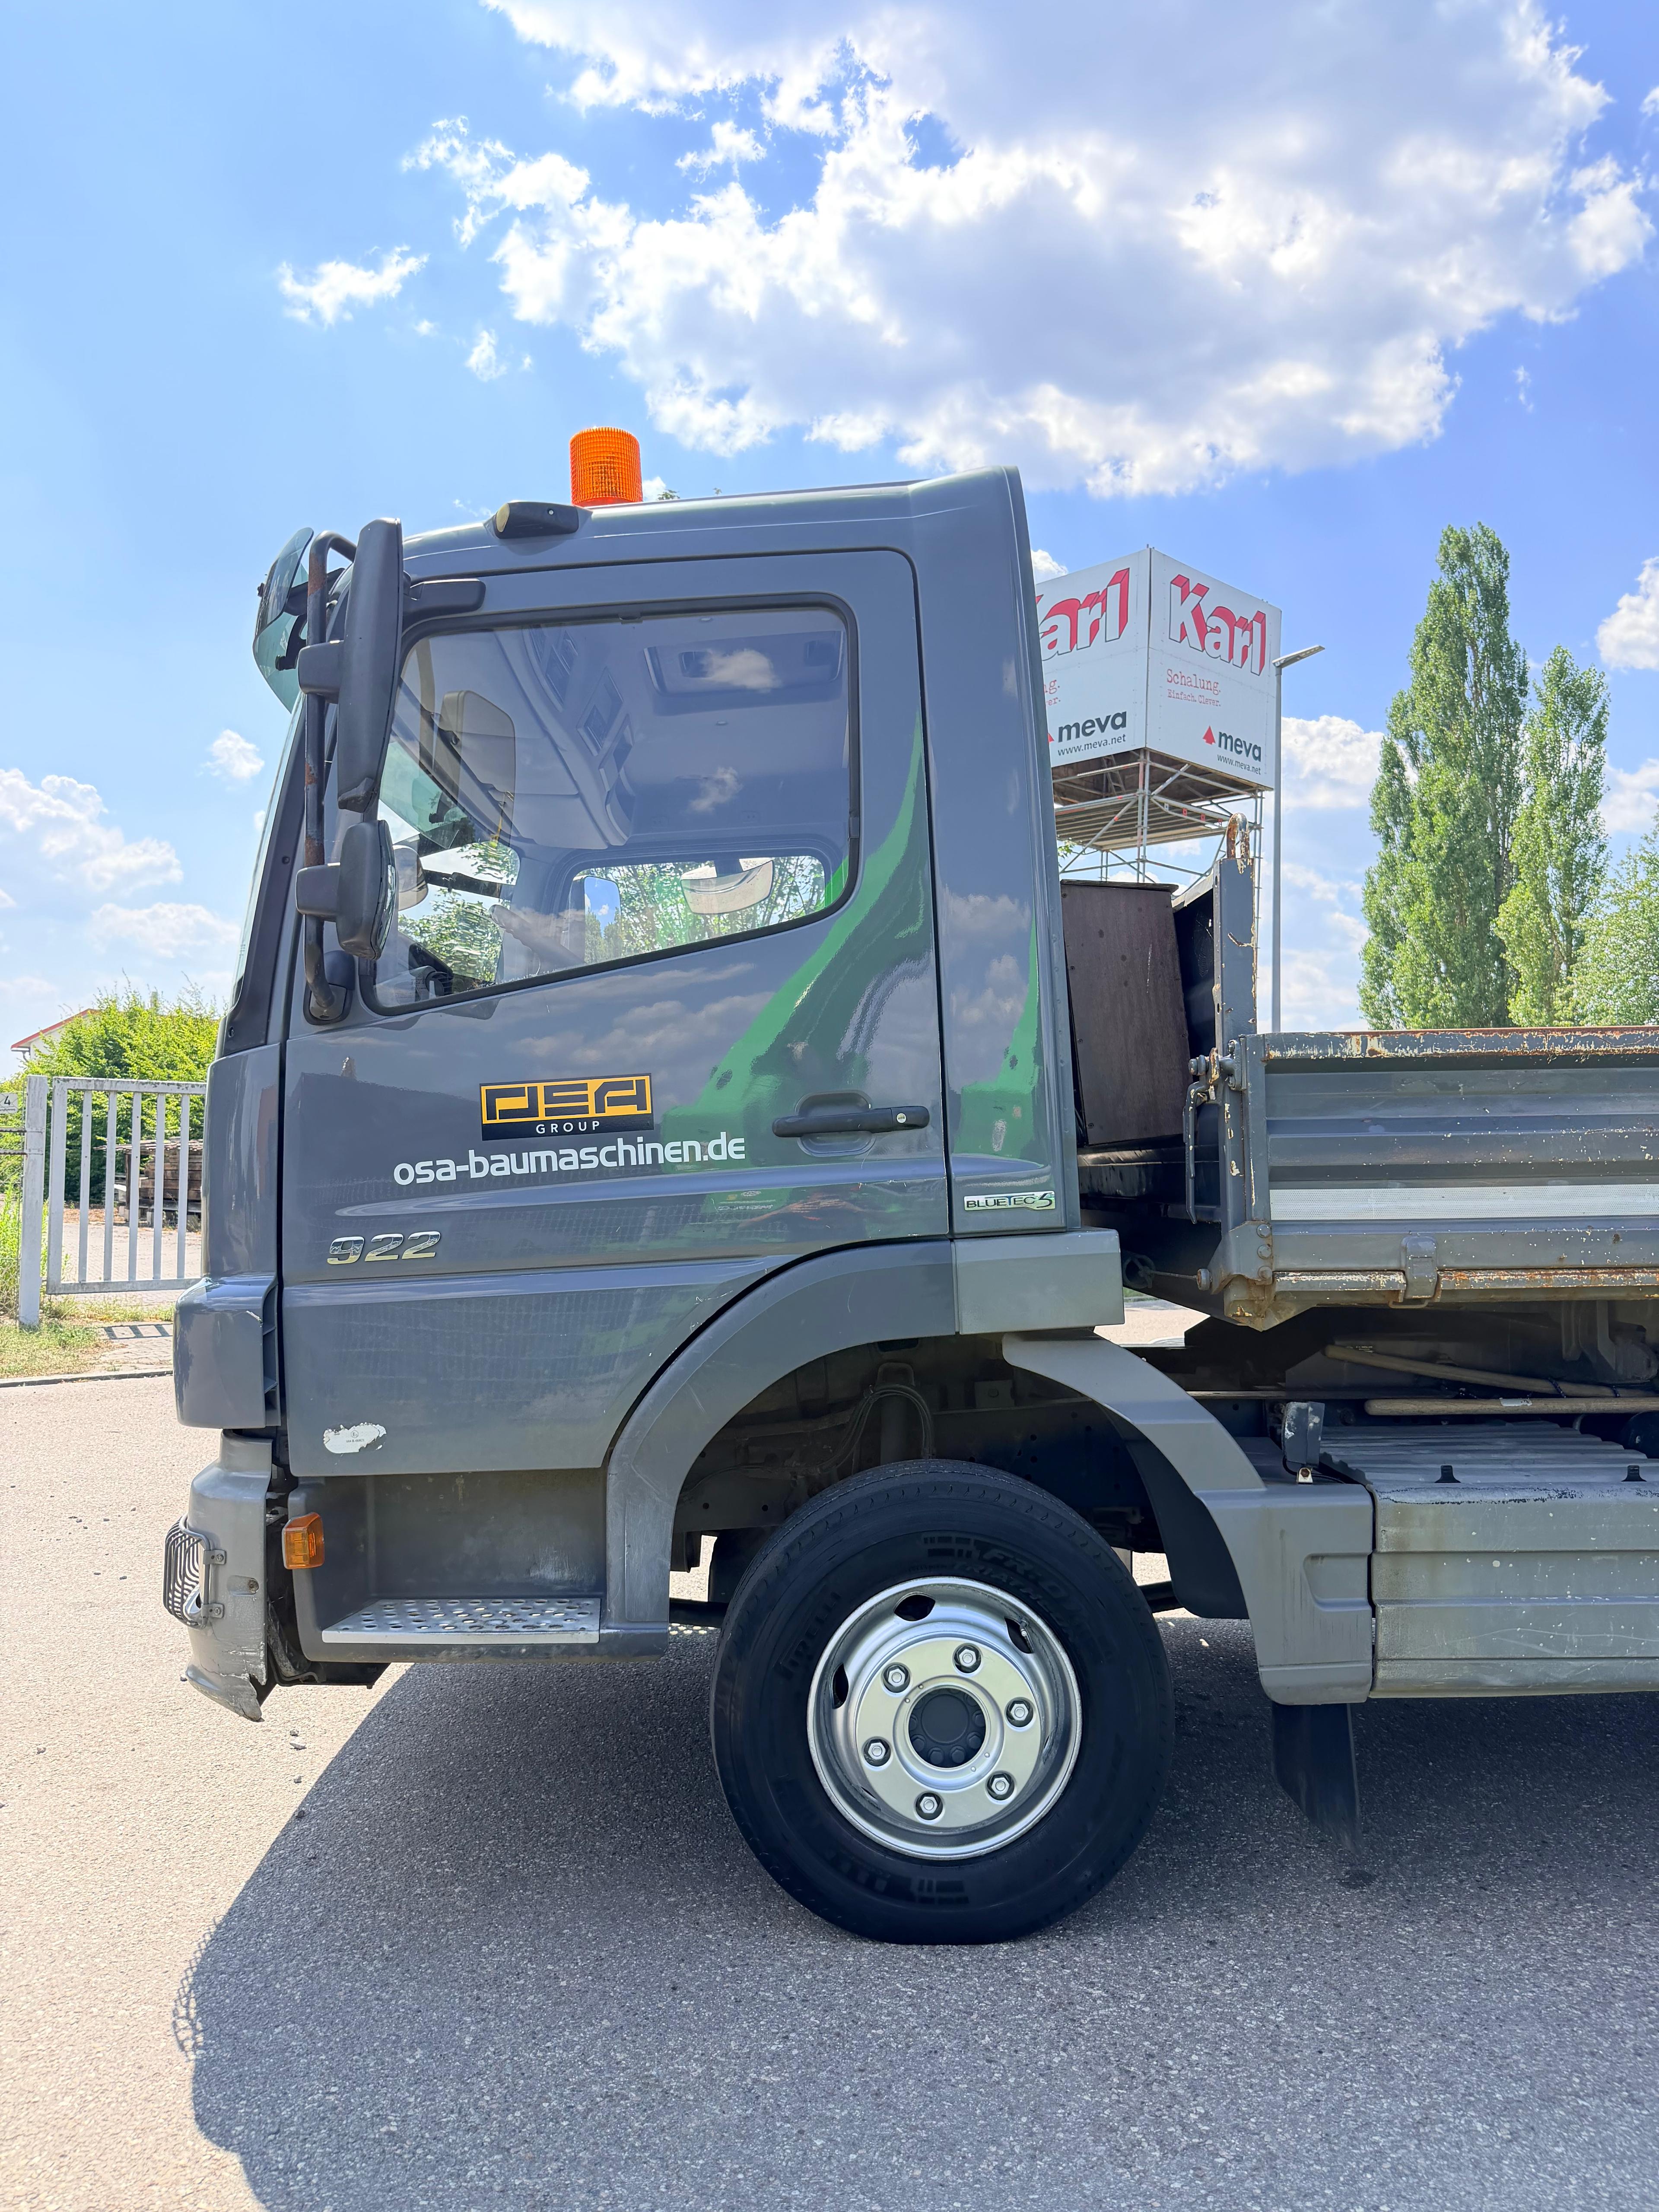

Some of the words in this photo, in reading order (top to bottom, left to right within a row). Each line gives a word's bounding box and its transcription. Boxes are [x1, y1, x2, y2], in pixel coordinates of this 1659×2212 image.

[1036, 568, 1128, 661] arl
[1169, 574, 1266, 676] Karl
[1167, 669, 1221, 696] Schalung.
[1167, 689, 1197, 702] Einfach.
[1198, 695, 1221, 706] Clever.
[1058, 711, 1127, 743] meva
[1058, 734, 1126, 756] www.meva.net
[1218, 731, 1261, 762] meva
[1217, 754, 1261, 775] www.meva.net
[536, 1121, 600, 1134] GROUP
[394, 1131, 746, 1185] osa-baumaschinen.de
[327, 1231, 441, 1265] 922
